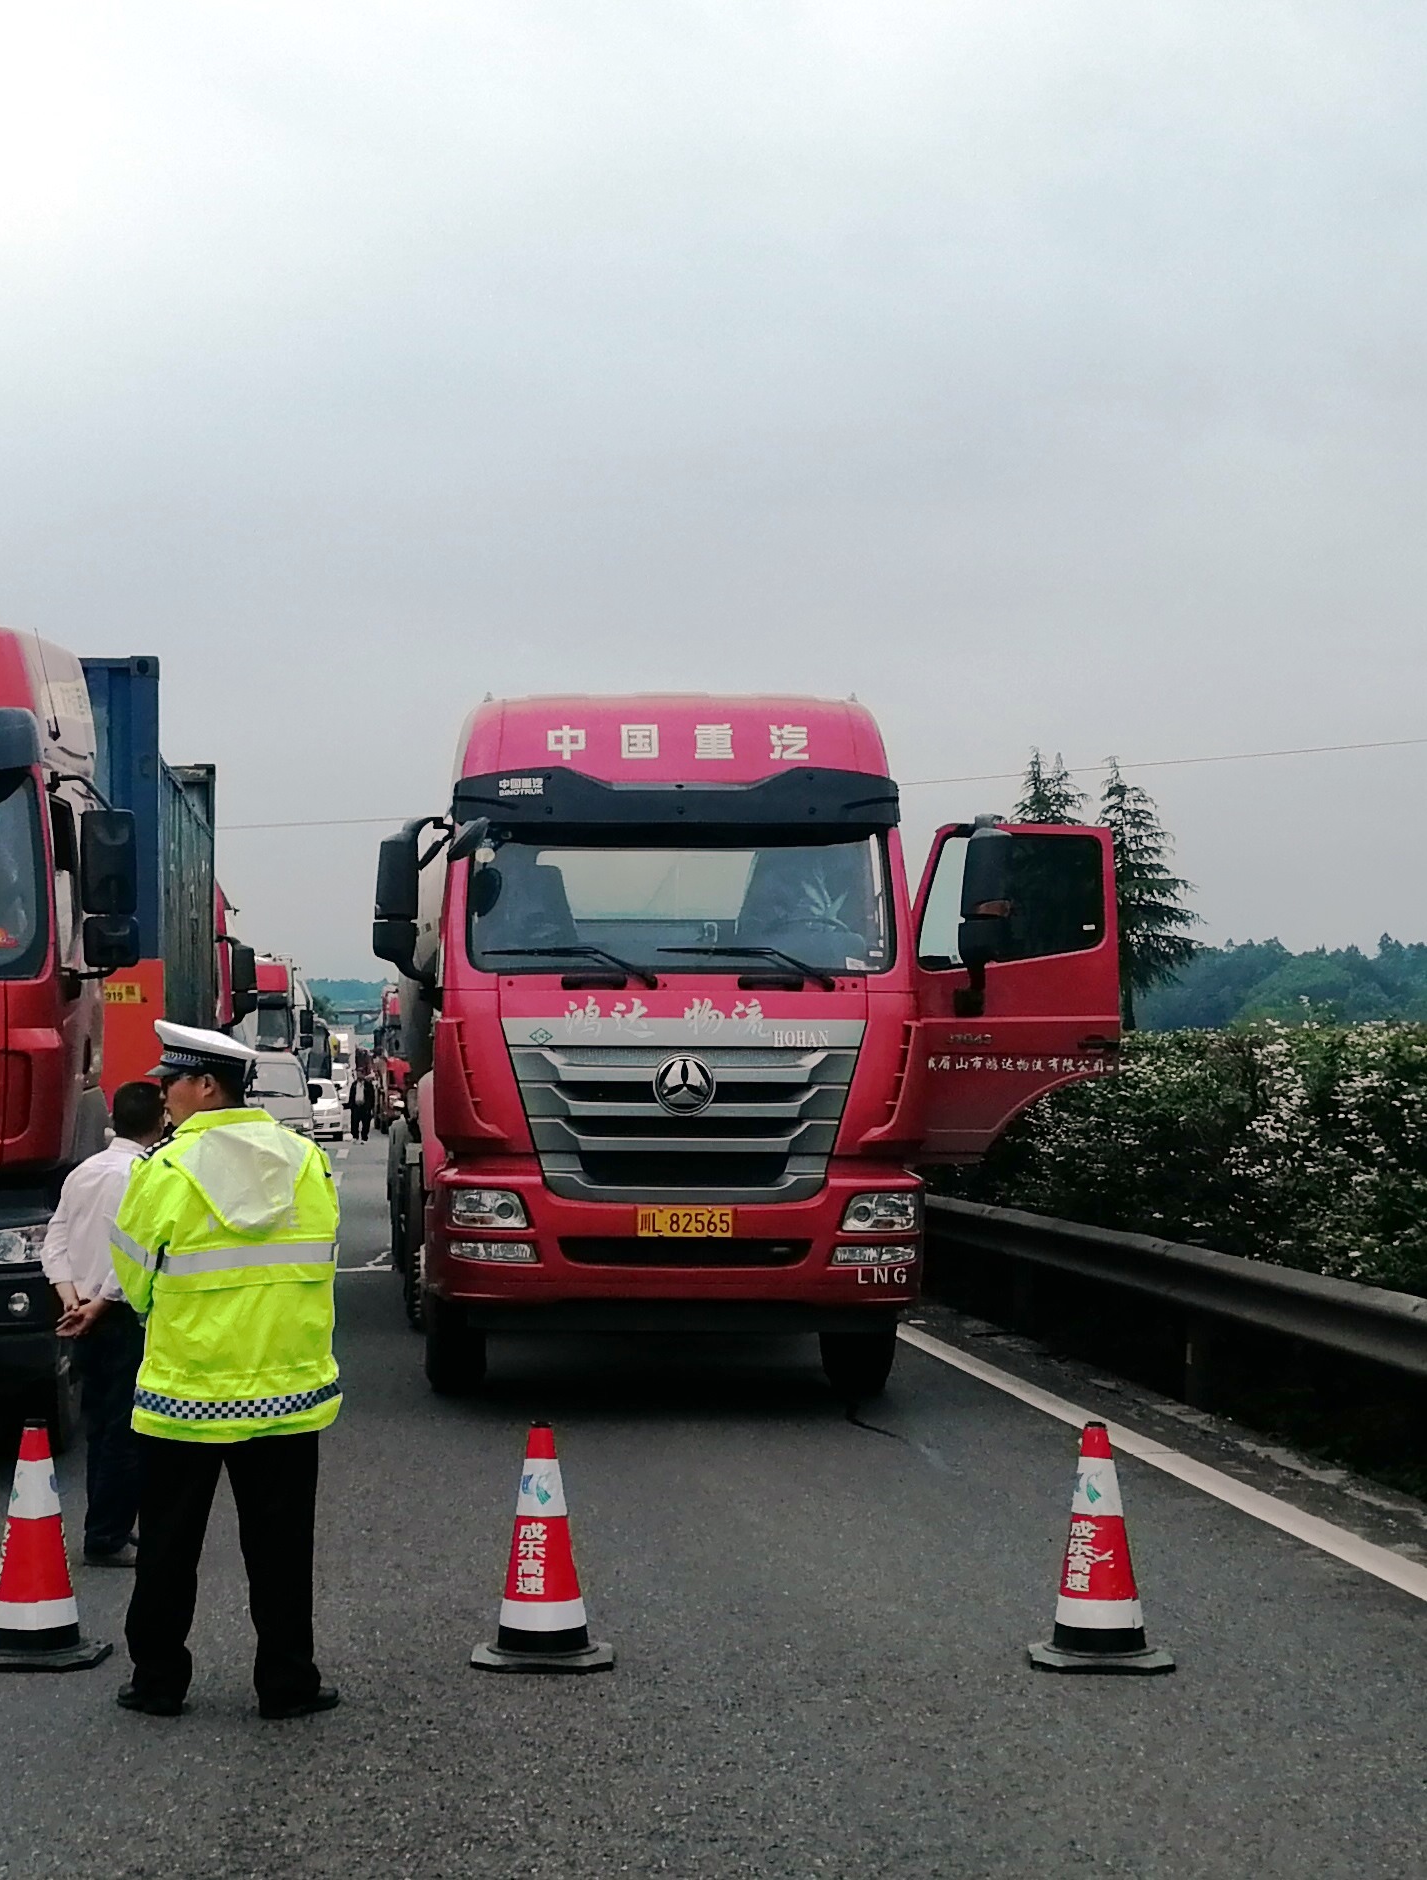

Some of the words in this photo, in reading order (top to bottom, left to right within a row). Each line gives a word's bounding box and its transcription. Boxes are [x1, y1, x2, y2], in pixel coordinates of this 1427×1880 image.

[547, 724, 810, 760] 中国重汽
[498, 778, 544, 789] 中国重汽
[564, 996, 655, 1038] 鸿达
[683, 998, 772, 1038] 物流
[772, 1030, 830, 1048] HOHAN
[857, 1266, 908, 1285] LNG
[515, 1522, 548, 1595] 成乐高速
